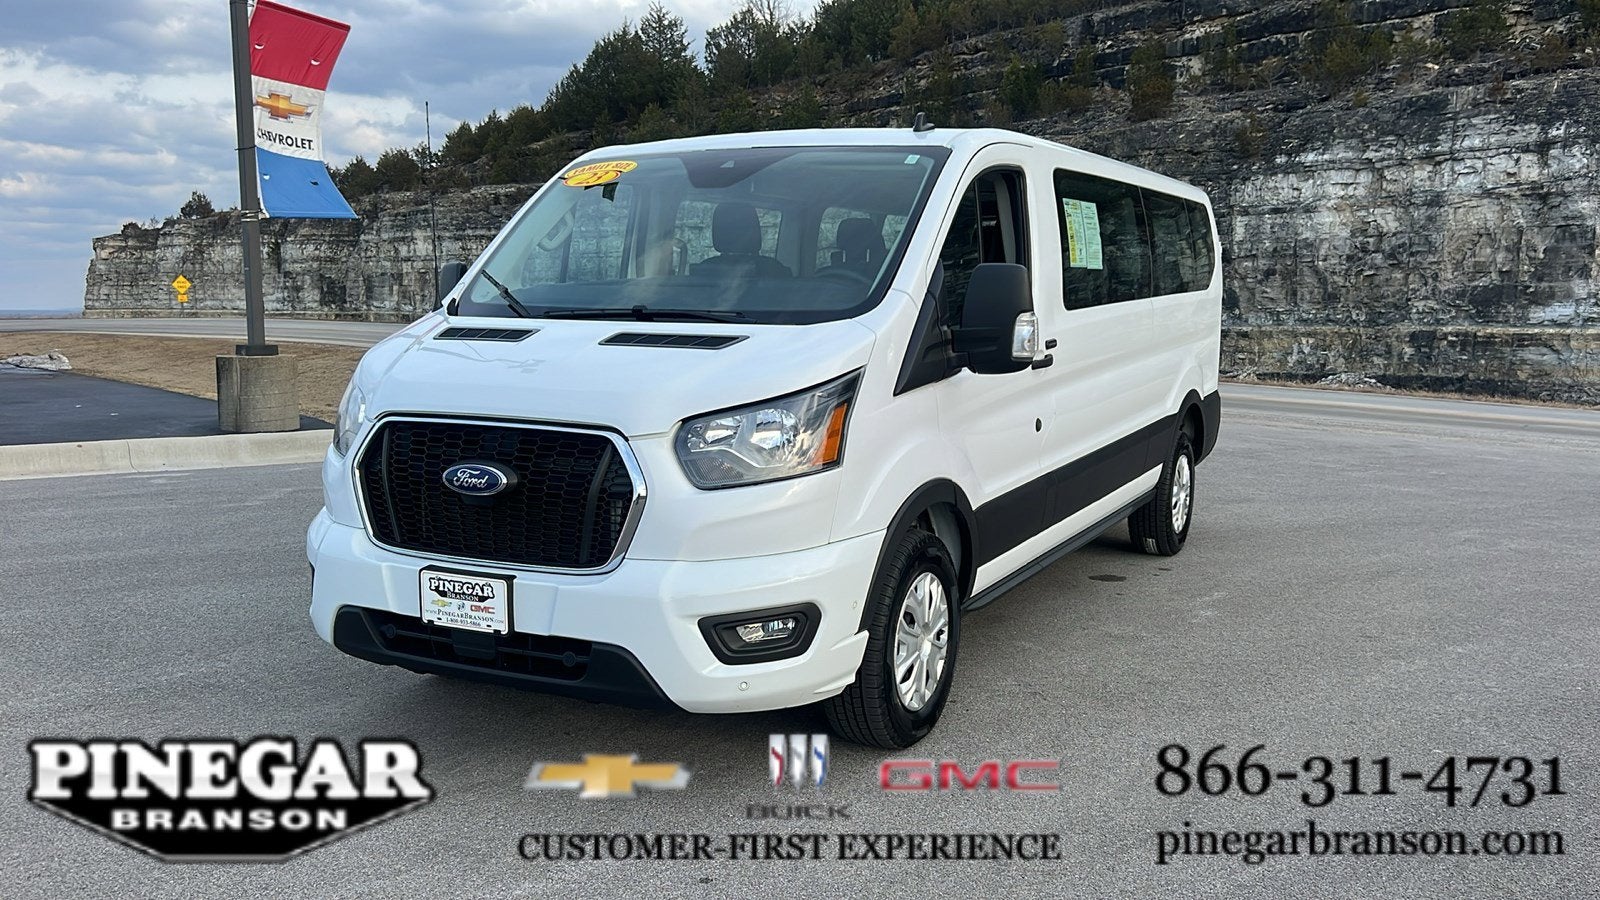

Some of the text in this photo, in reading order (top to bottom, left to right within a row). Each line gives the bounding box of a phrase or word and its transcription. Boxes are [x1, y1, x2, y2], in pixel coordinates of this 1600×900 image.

[257, 128, 313, 150] CHEVROLET
[453, 468, 489, 488] Ford
[430, 579, 495, 598] PINEGAR
[446, 590, 479, 602] BRANSON
[470, 604, 495, 614] GMC
